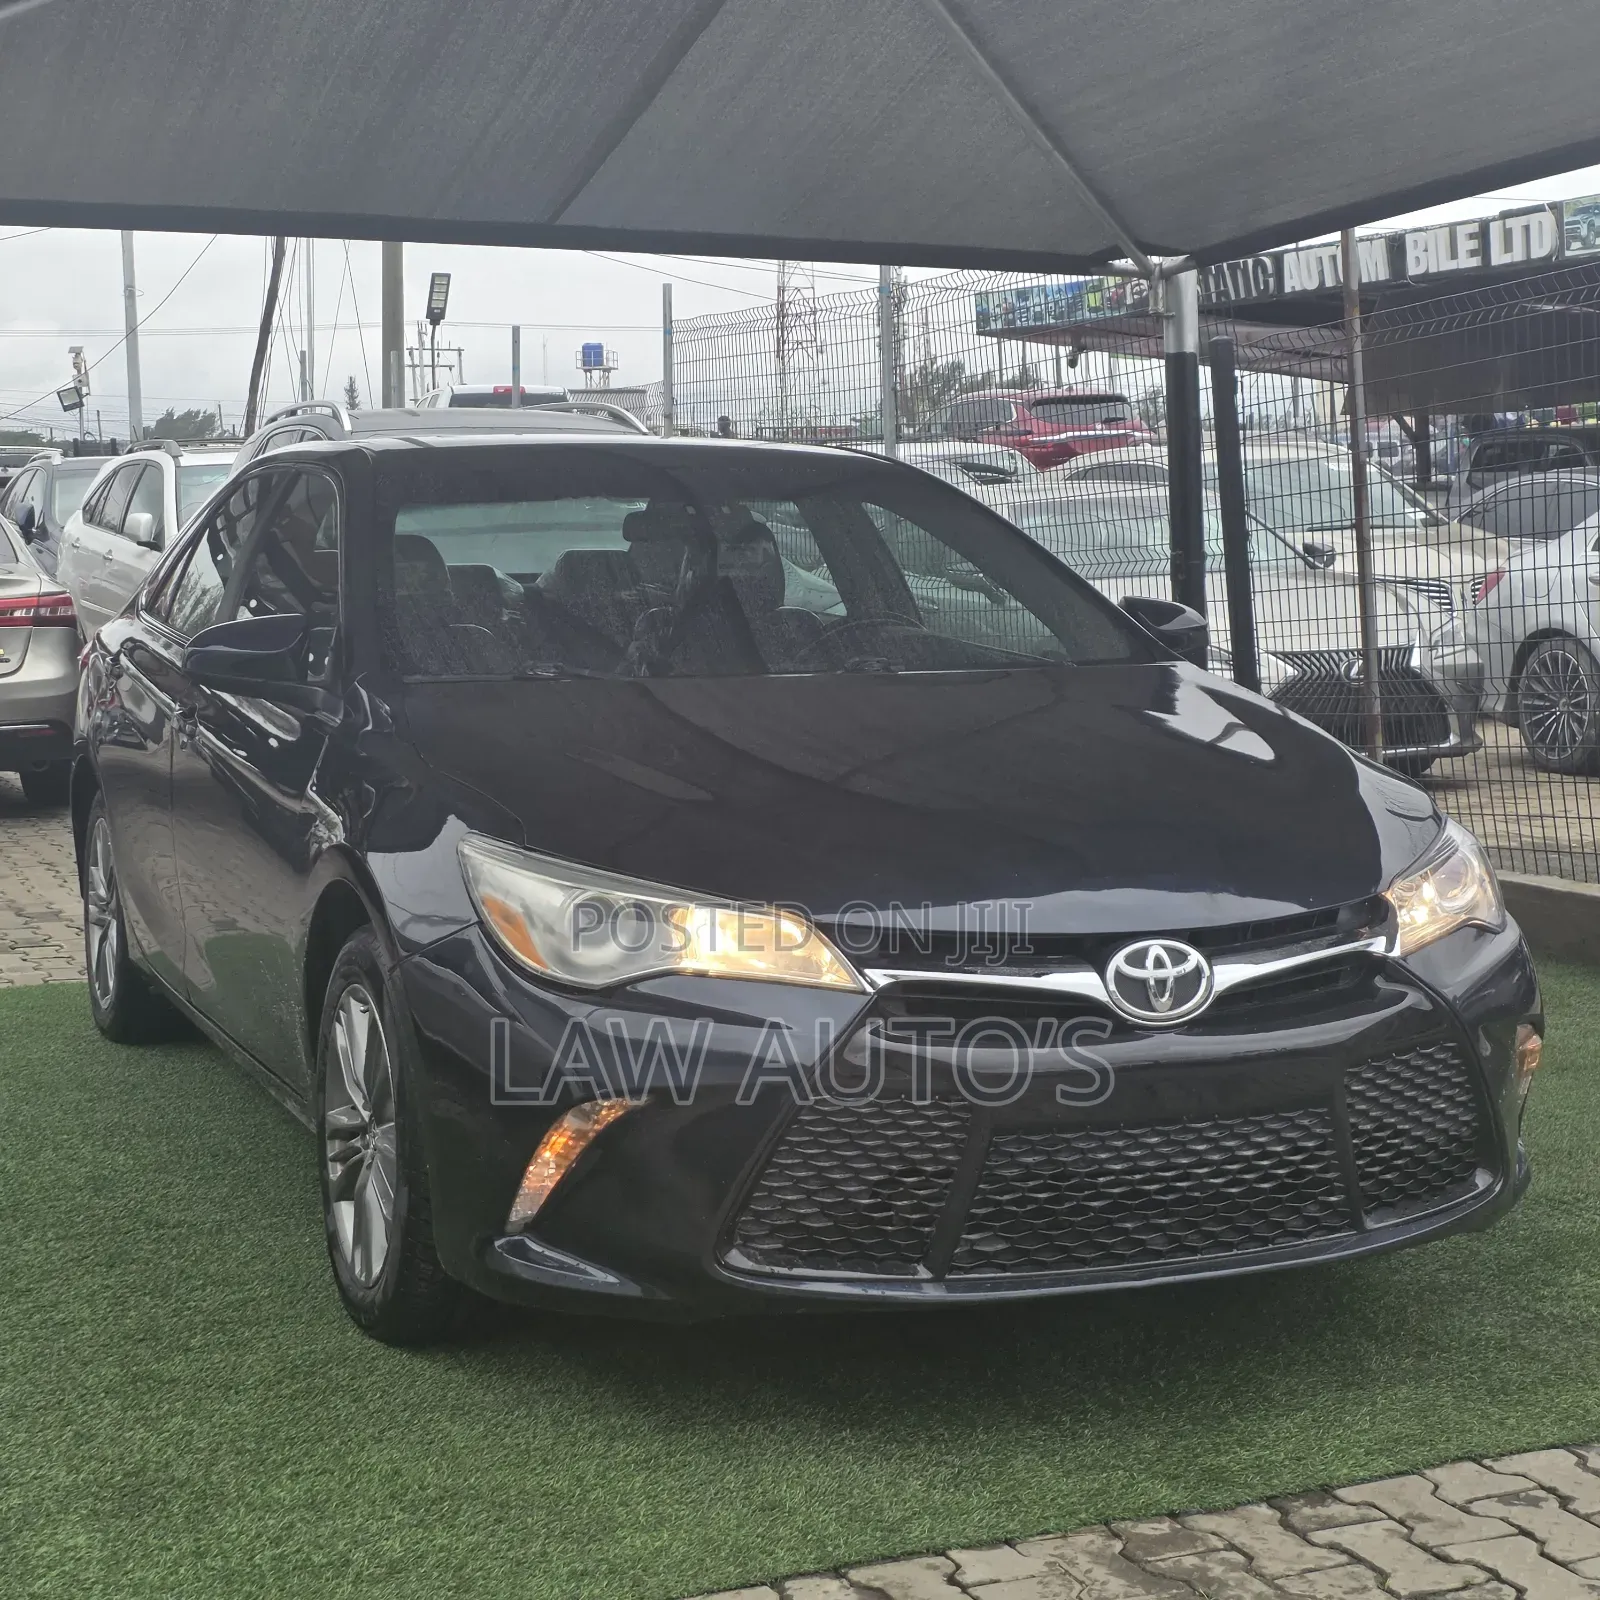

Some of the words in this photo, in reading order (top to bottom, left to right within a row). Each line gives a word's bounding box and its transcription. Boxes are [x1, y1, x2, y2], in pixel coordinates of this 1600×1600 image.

[1198, 255, 1276, 304] TATIC
[1405, 223, 1482, 276] BILE
[1490, 211, 1556, 266] LTD
